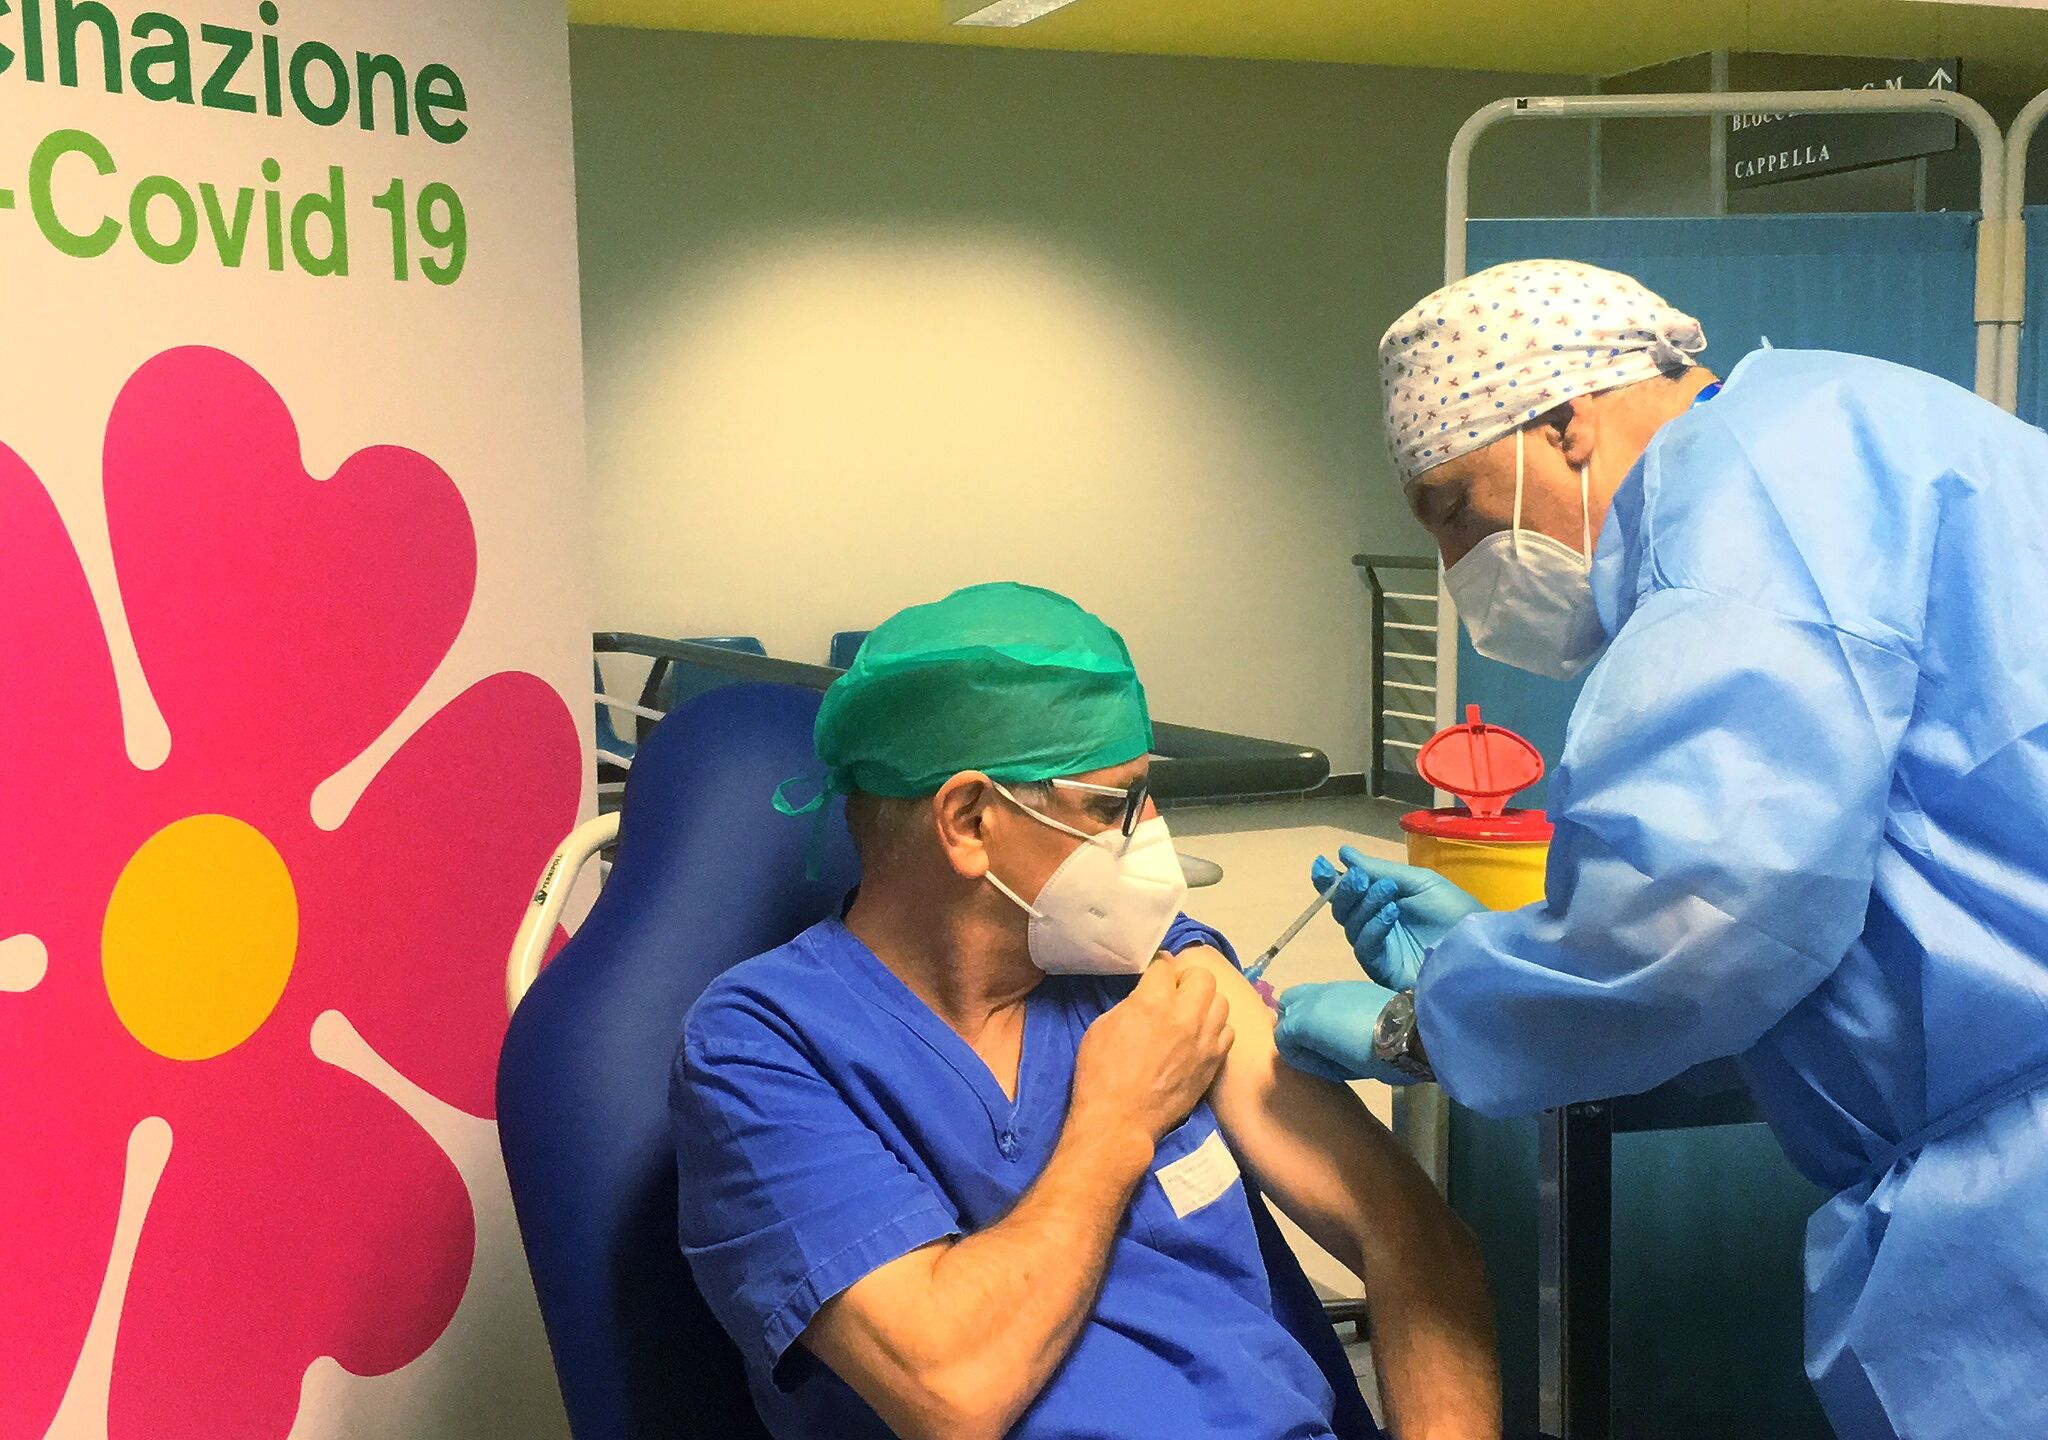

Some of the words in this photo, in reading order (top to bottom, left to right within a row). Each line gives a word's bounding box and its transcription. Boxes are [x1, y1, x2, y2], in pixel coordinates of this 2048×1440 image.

[0, 0, 468, 144] inazione
[1735, 145, 1830, 178] CAPPELLA
[372, 178, 468, 286] 19
